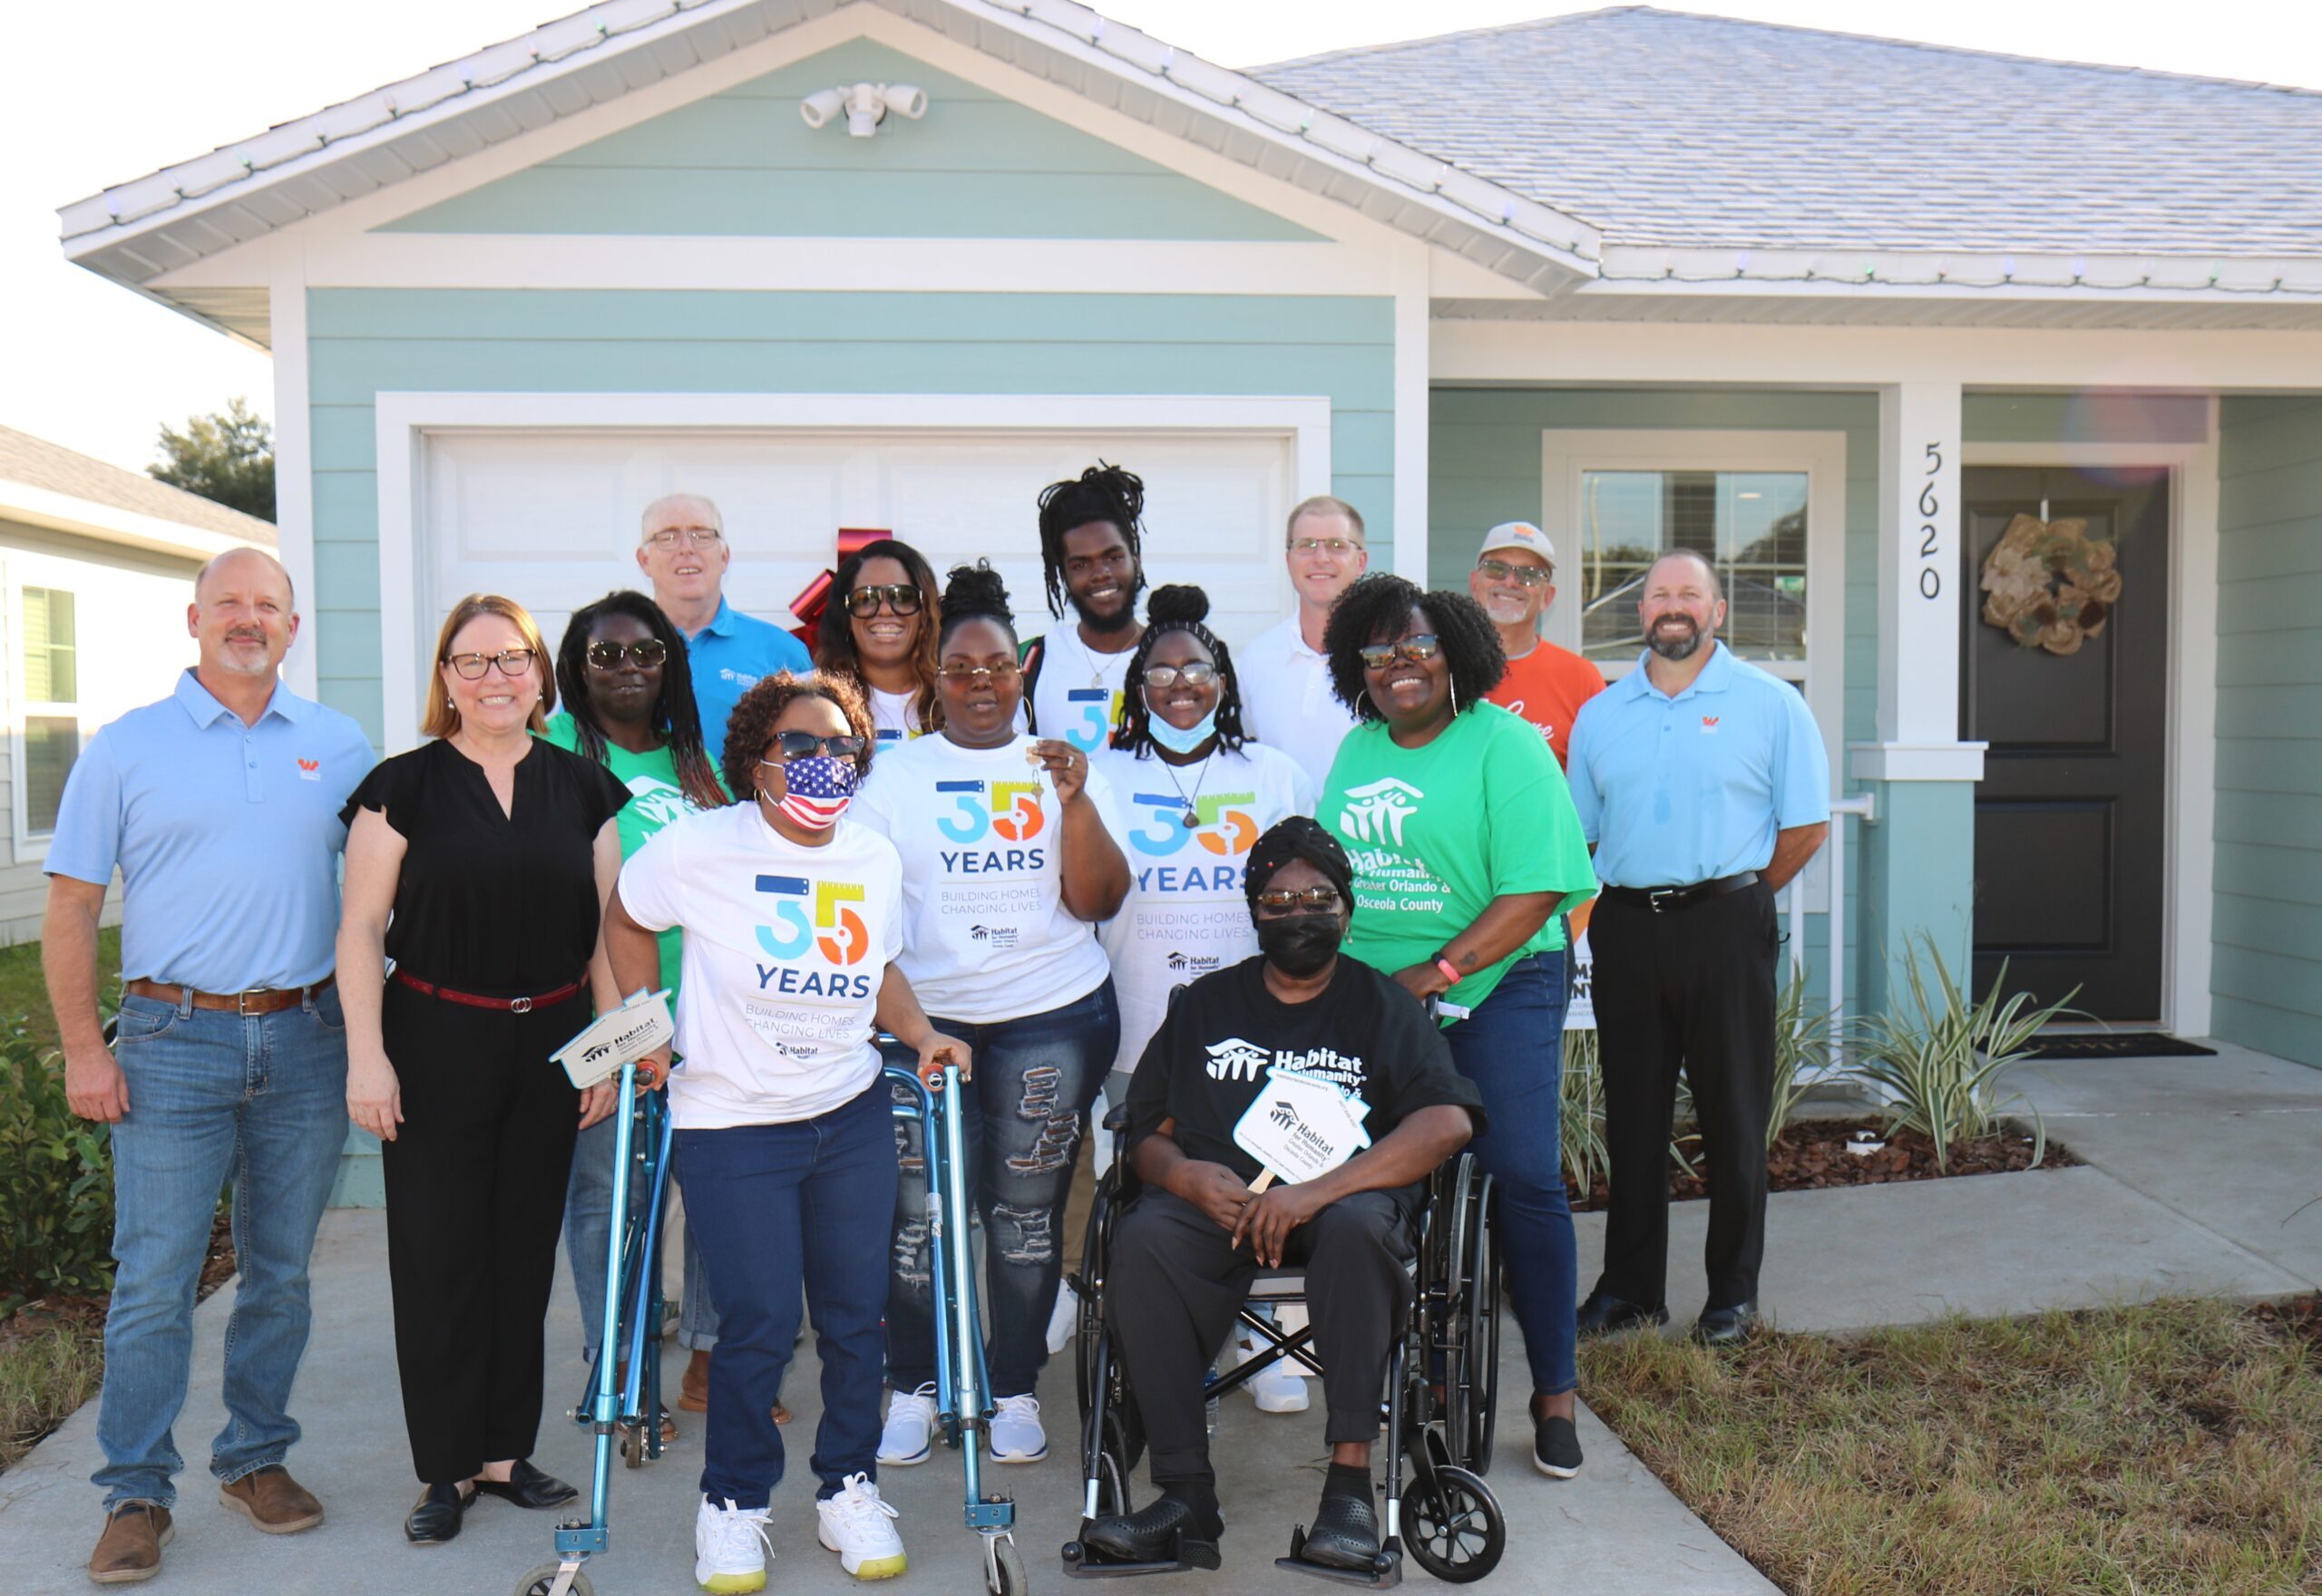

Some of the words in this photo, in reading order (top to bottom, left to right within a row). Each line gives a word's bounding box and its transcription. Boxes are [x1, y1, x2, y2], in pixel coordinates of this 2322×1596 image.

[1919, 441, 1942, 599] 5620
[936, 780, 1045, 843] 35
[1128, 792, 1259, 857] 35
[940, 848, 1045, 873] YEARS
[941, 890, 998, 901] BUILDING
[1353, 877, 1386, 891] Greater
[1390, 880, 1438, 892] Orlando
[1441, 881, 1451, 893] &
[941, 903, 1007, 914] CHANGING
[1357, 894, 1396, 910] Osceola
[1400, 899, 1443, 914] County
[755, 874, 869, 966] 35
[1137, 913, 1199, 925] BUILDING
[991, 928, 1017, 936] Habitat
[1137, 929, 1209, 940] CHANGING
[1190, 957, 1219, 965] Habitat
[756, 963, 871, 998] YEARS
[746, 1004, 807, 1023] BUILDING
[810, 1013, 855, 1026] HOMES
[614, 1017, 654, 1045] Habitat
[790, 1046, 818, 1055] Habitat
[1274, 1047, 1362, 1074] Habitat
[1293, 1133, 1301, 1142] for
[1297, 1123, 1334, 1155] Habitat
